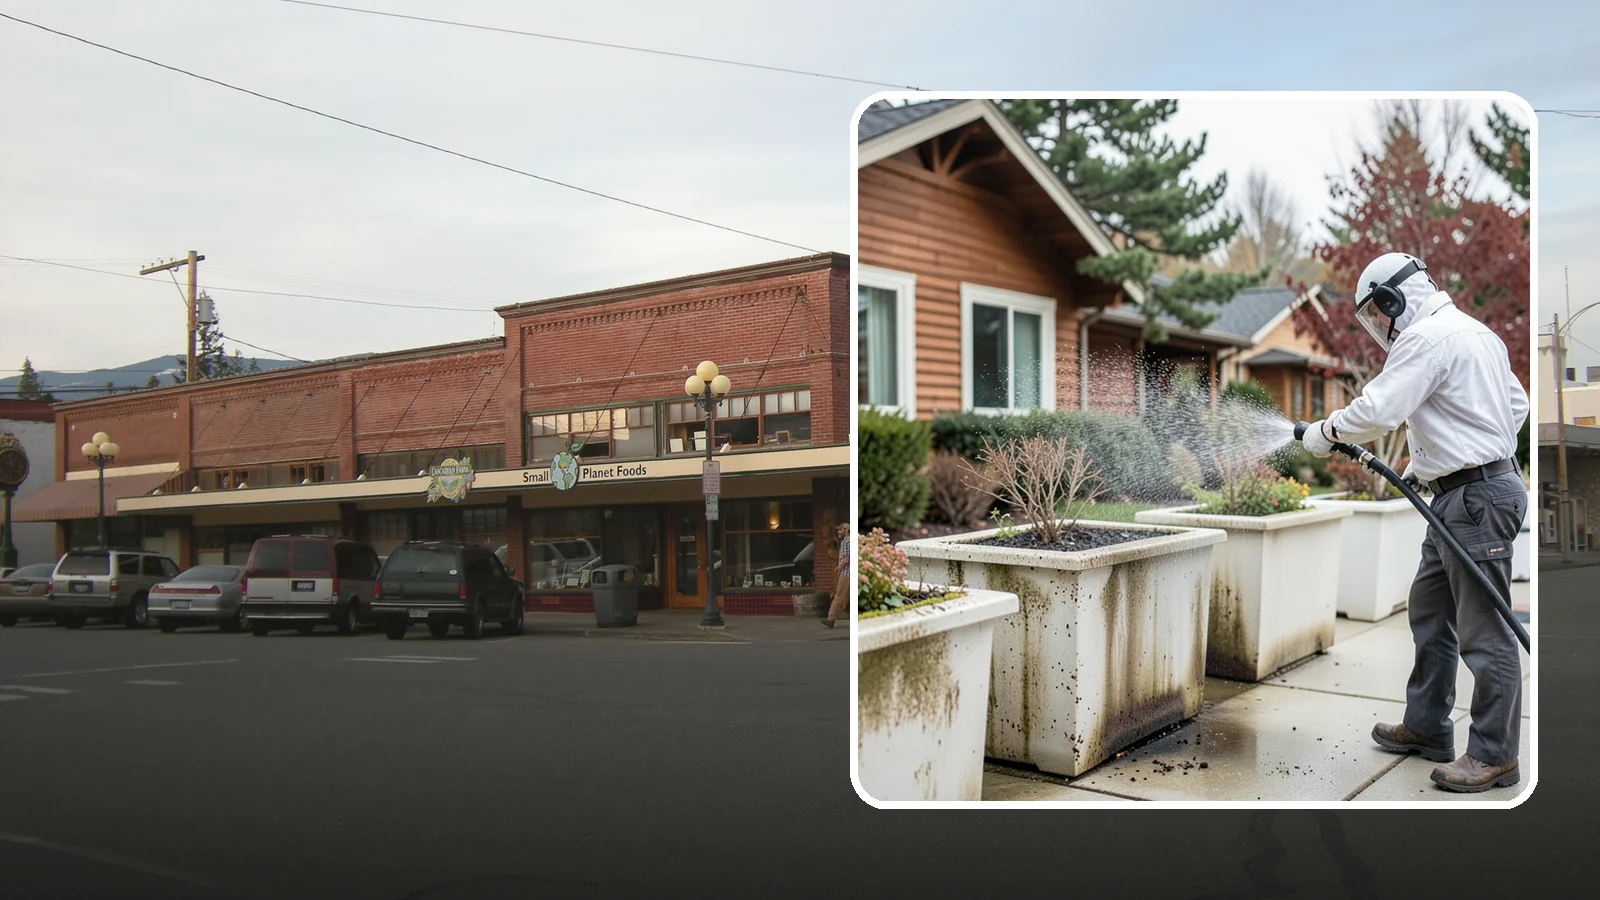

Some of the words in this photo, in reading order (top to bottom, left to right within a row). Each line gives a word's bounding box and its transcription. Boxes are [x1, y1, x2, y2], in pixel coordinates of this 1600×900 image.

[523, 471, 549, 483] Small
[583, 468, 614, 479] Planet
[617, 464, 647, 477] Foods
